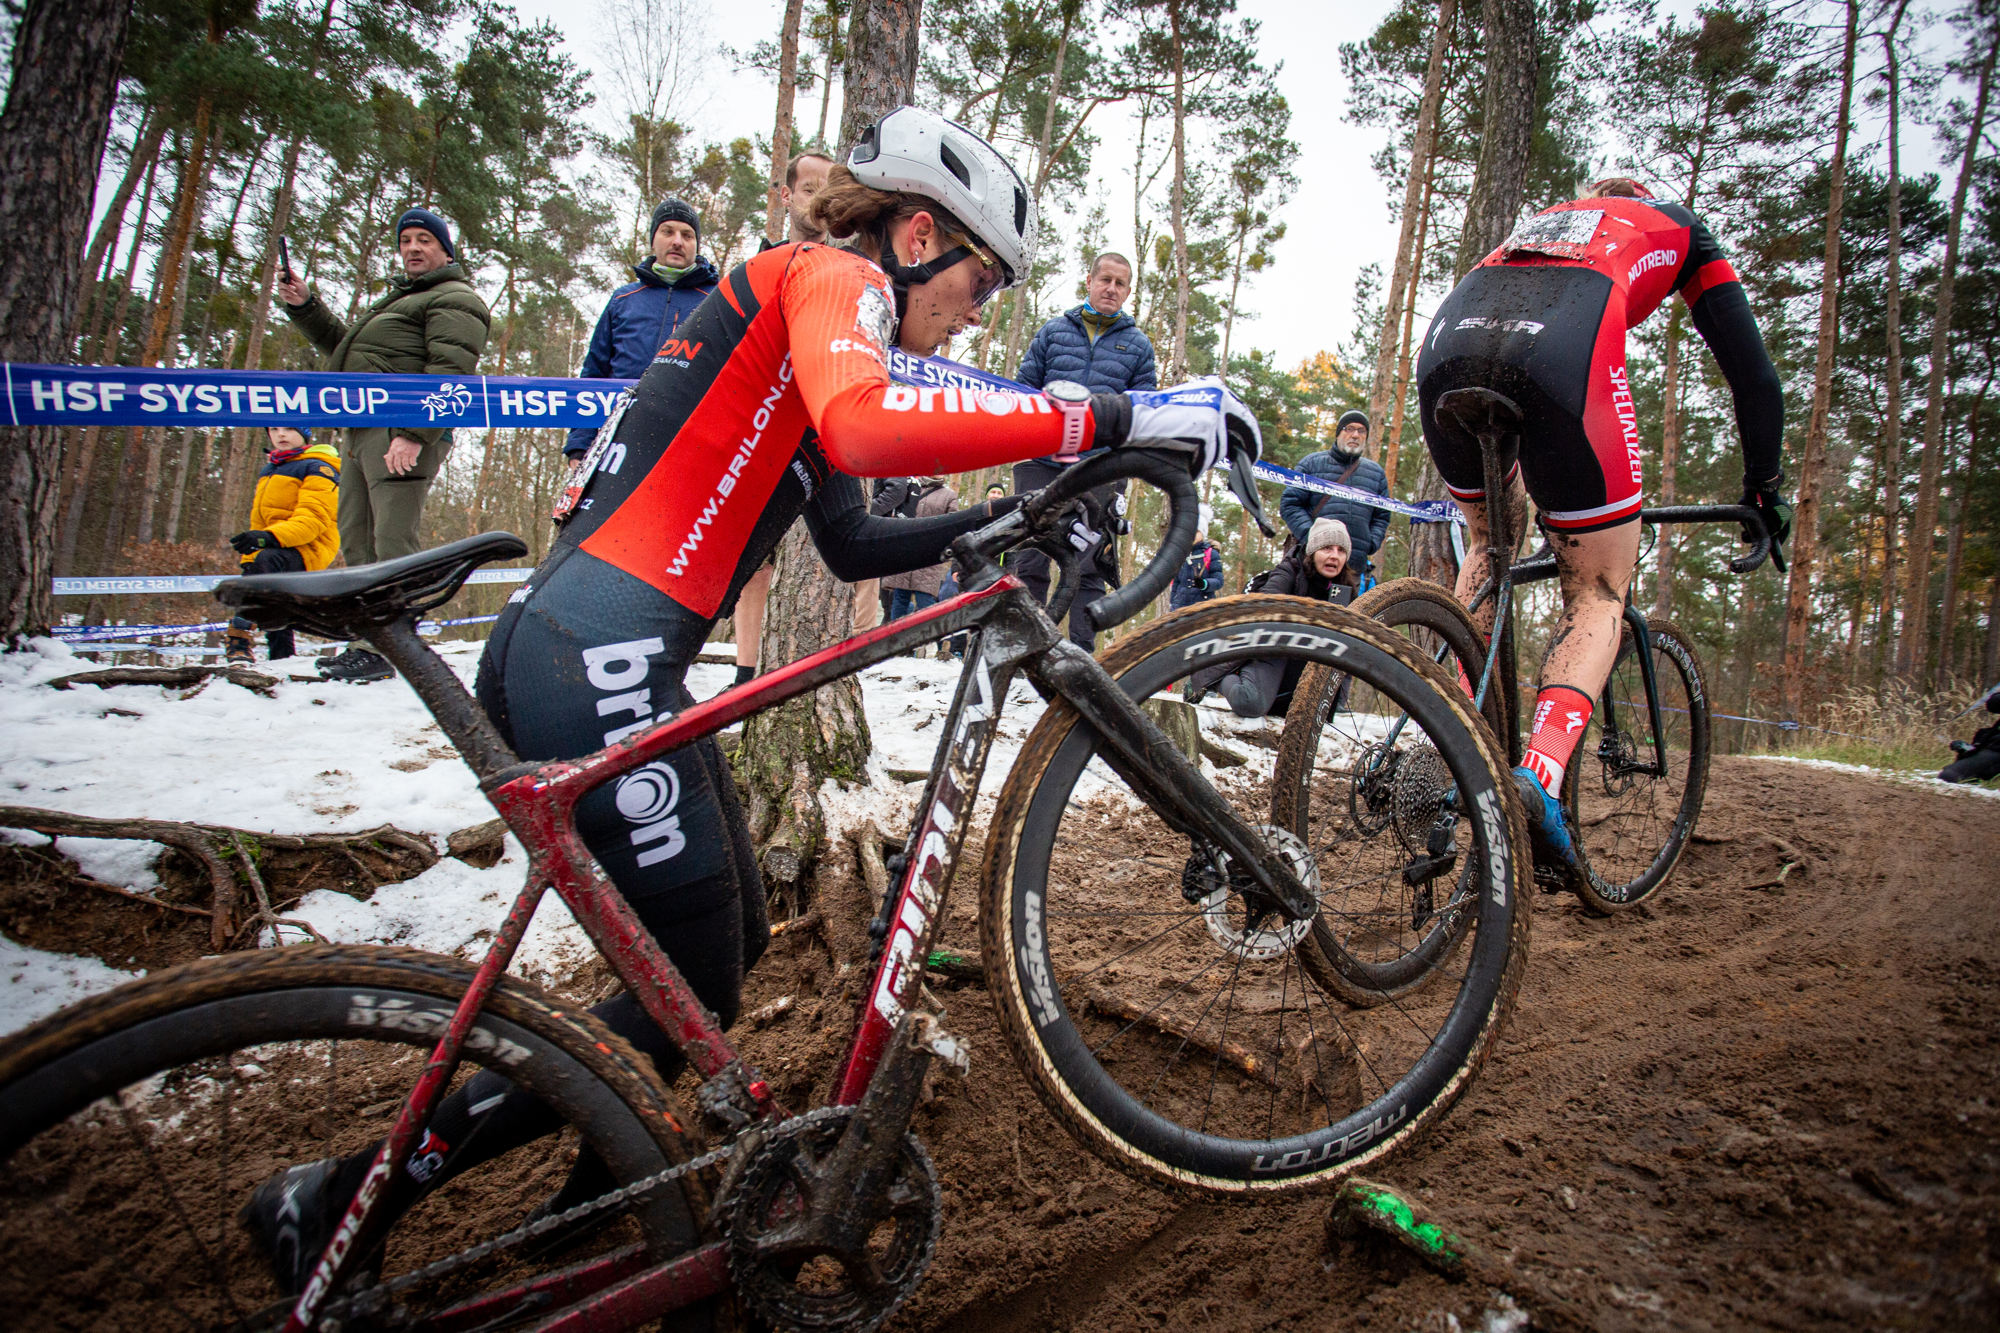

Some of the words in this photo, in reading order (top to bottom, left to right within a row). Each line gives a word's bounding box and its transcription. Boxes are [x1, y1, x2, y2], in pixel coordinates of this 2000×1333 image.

[1628, 249, 1677, 285] NUTREND
[31, 380, 125, 413] HSF
[140, 383, 309, 415] SYSTEM
[318, 387, 389, 415] CUP
[501, 389, 567, 416] HSF
[1169, 391, 1217, 404] swix
[1608, 365, 1642, 484] SPECIALIZED
[1184, 628, 1349, 661] metron
[582, 637, 685, 868] brion
[1251, 1104, 1407, 1172] metron
[294, 1148, 392, 1327] RIDLEY
